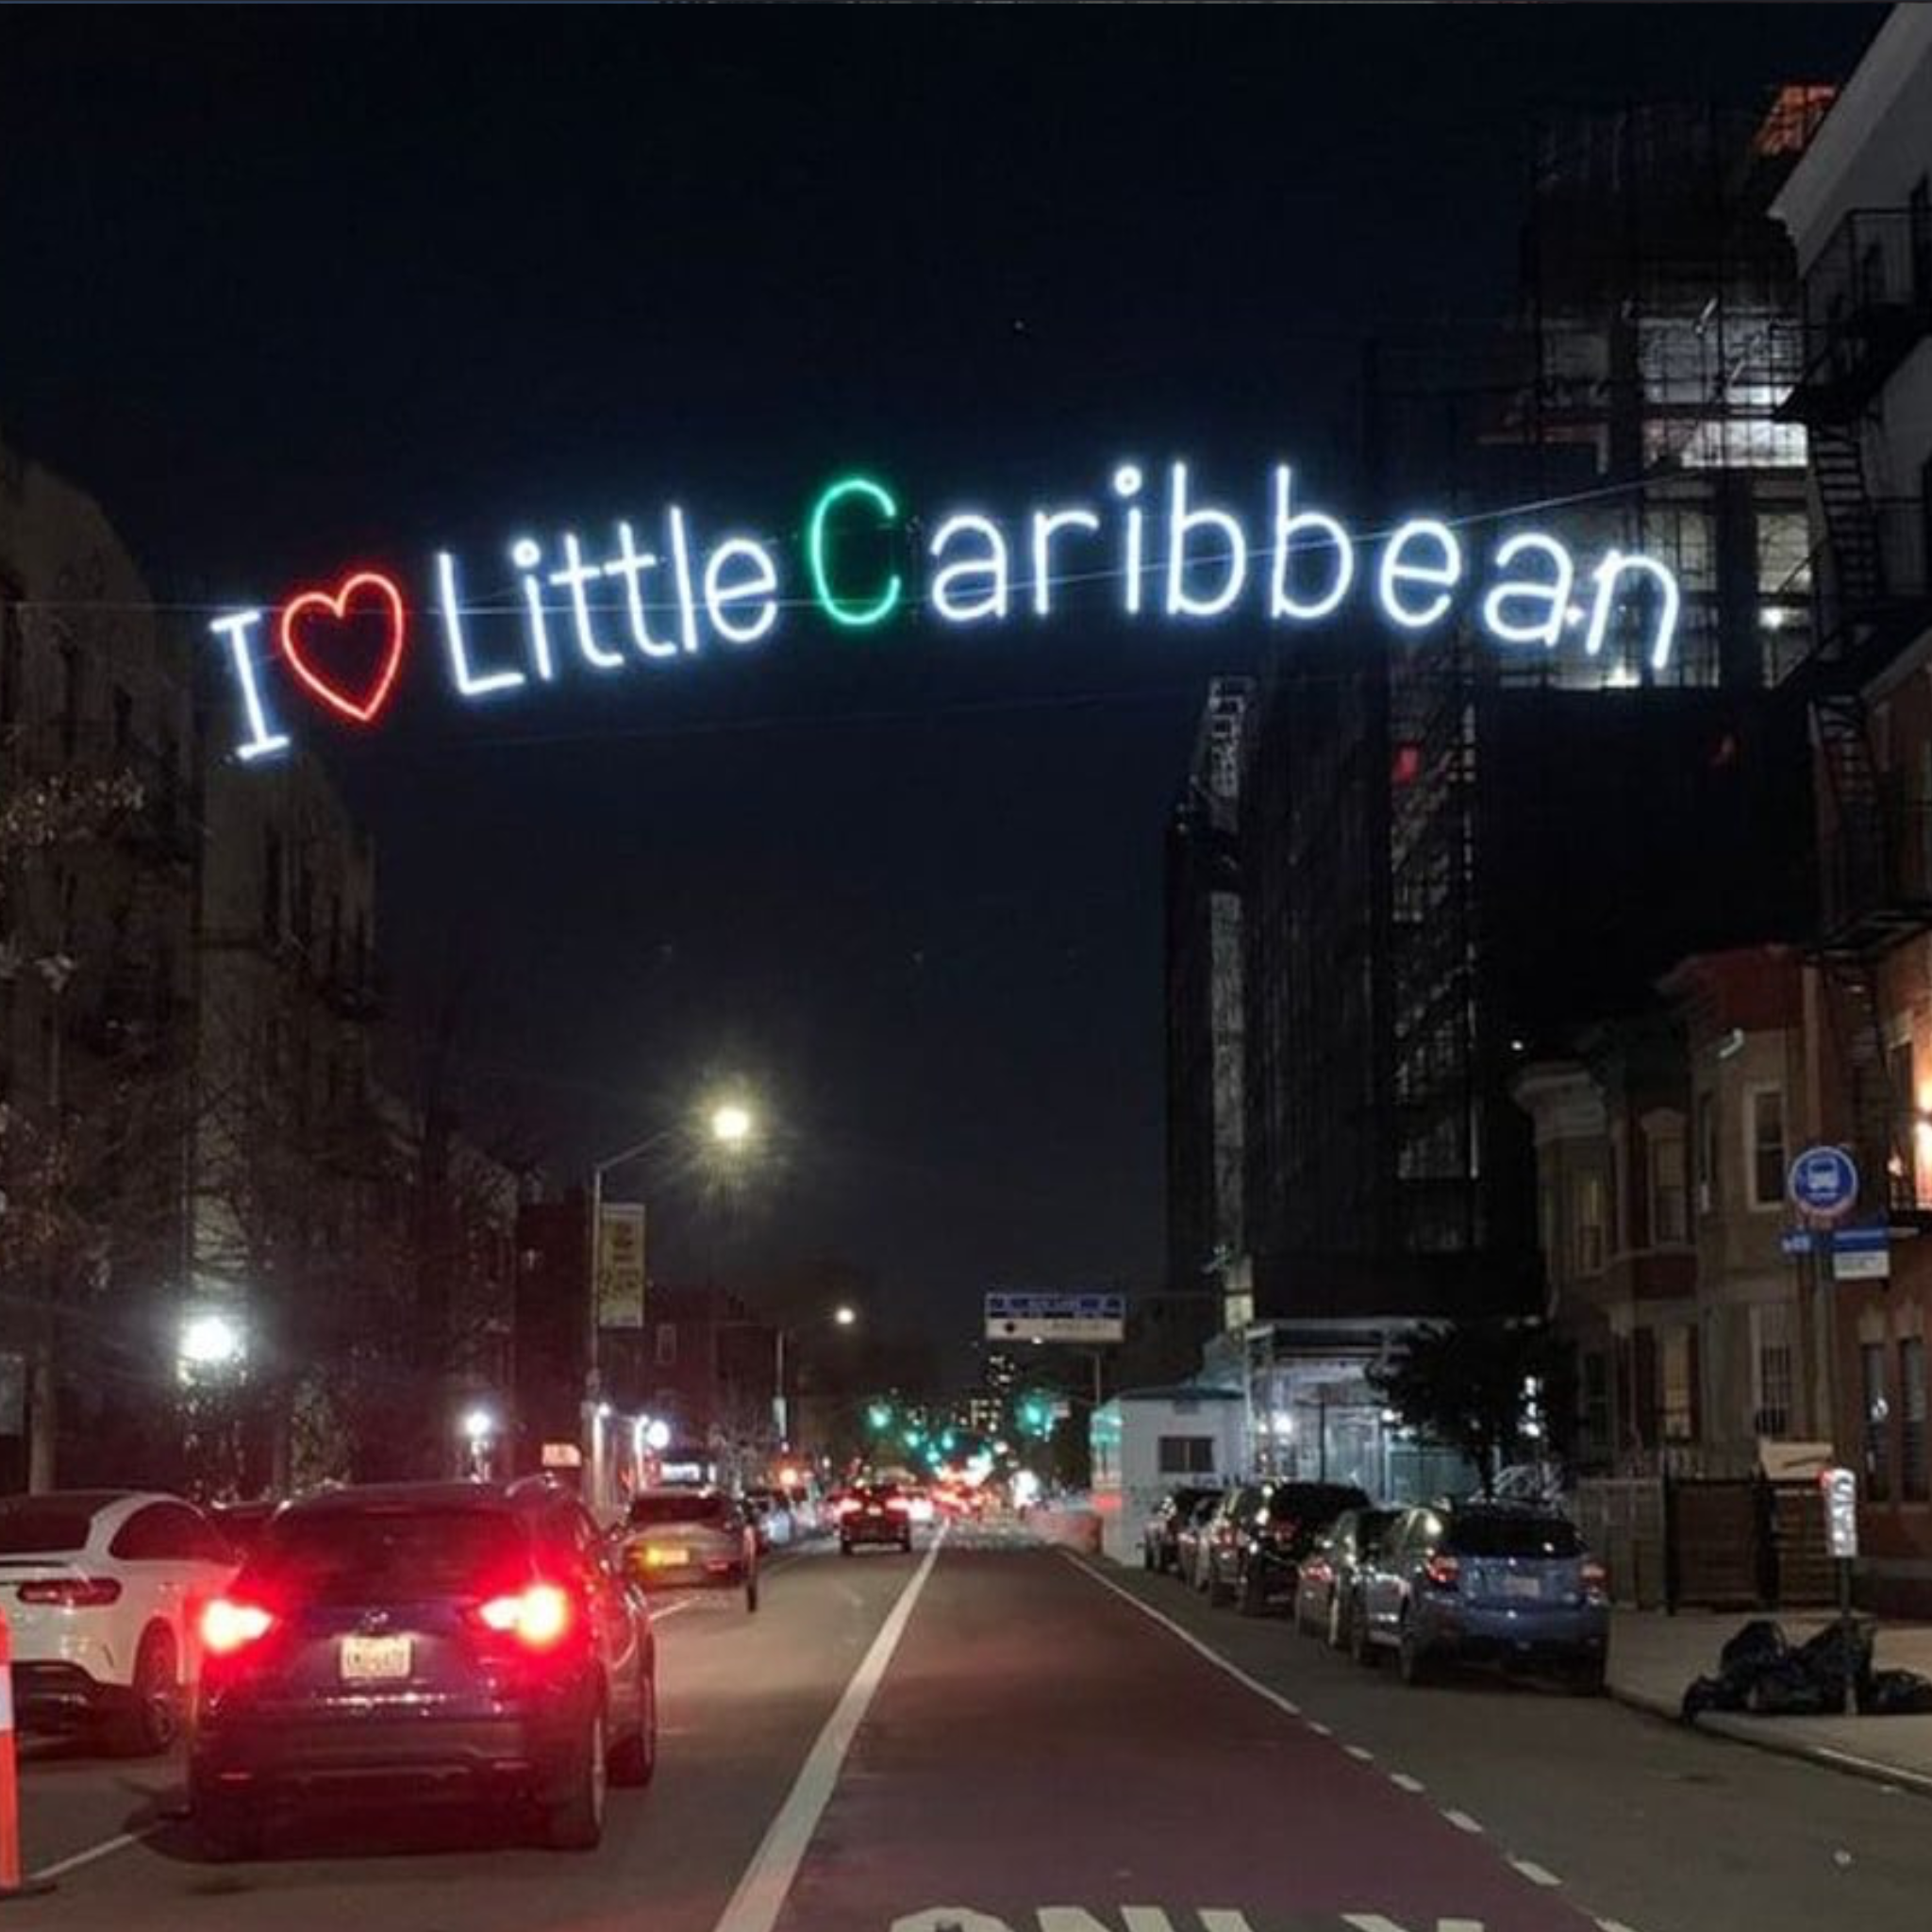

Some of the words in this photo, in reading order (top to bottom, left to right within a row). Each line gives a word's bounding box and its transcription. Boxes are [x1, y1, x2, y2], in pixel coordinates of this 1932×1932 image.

[209, 608, 290, 762] I
[436, 504, 779, 697] Little
[807, 459, 1682, 672] Caribbean
